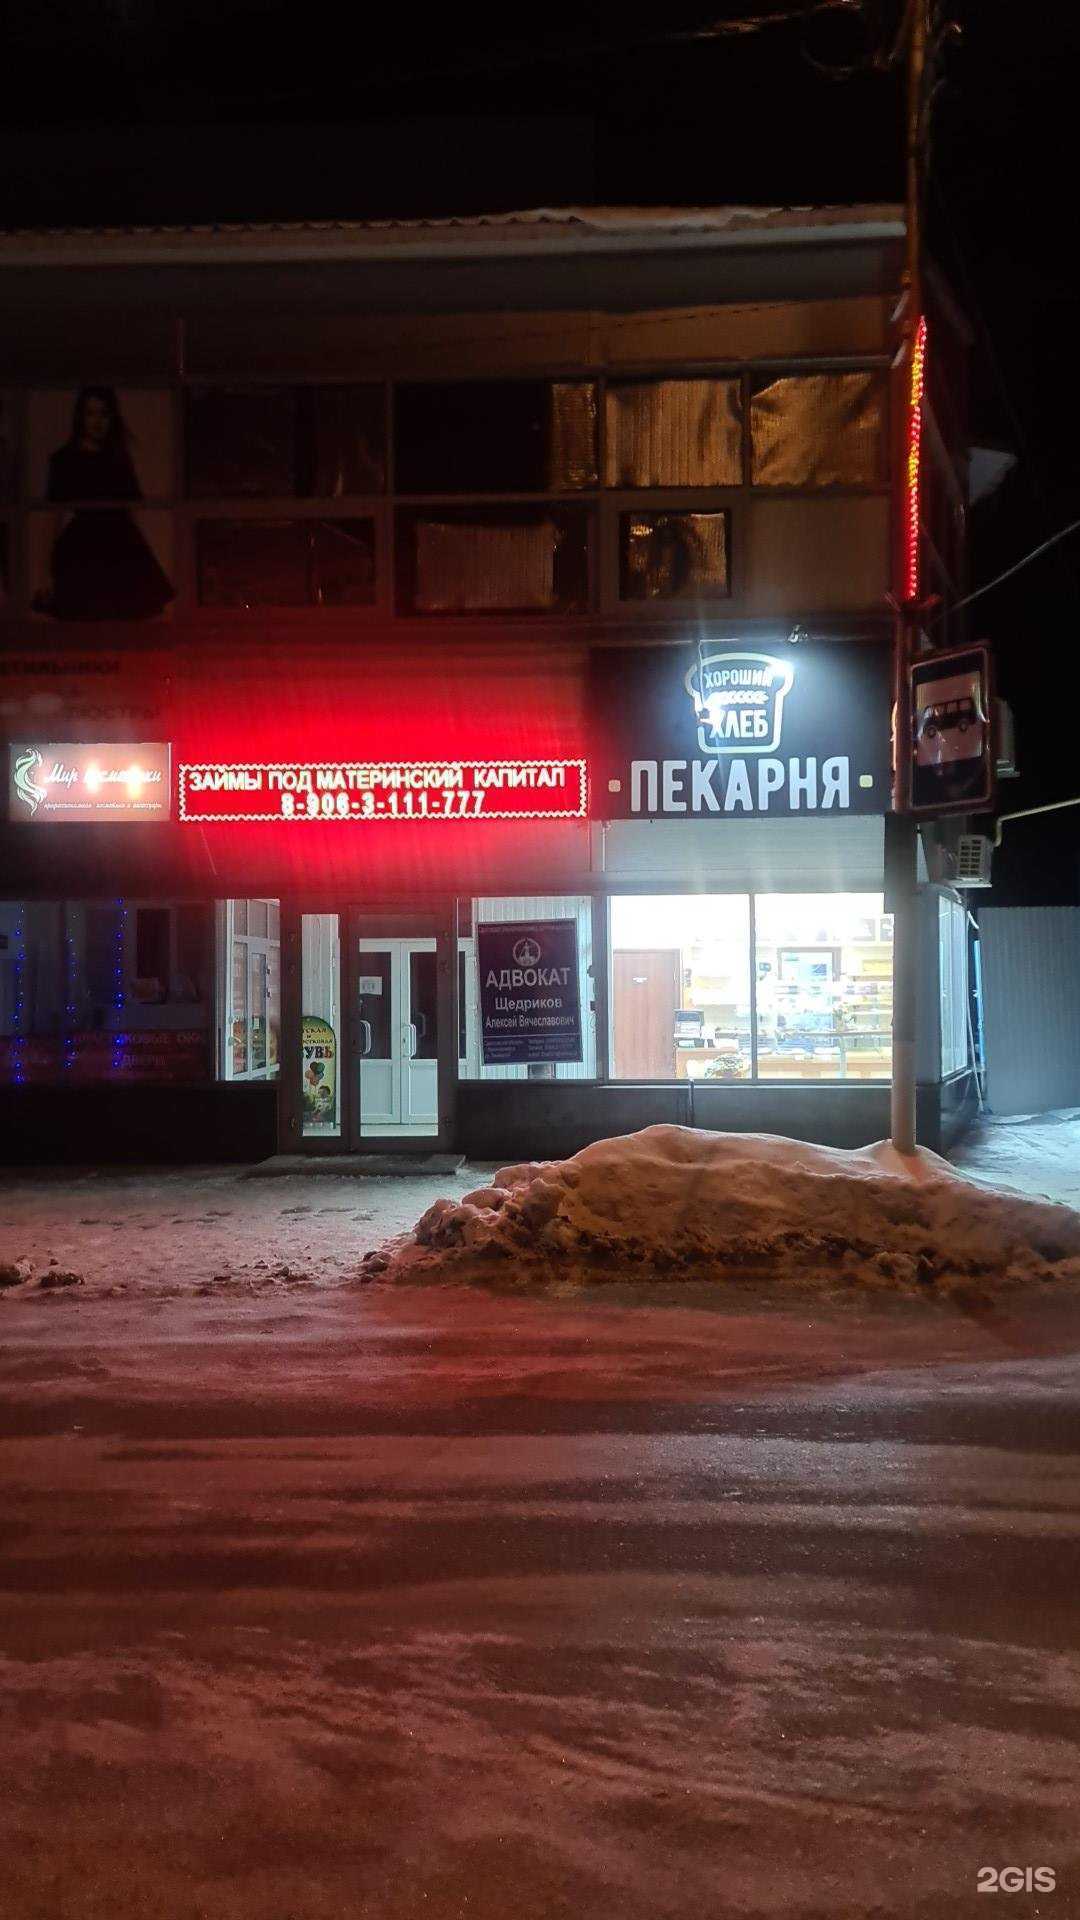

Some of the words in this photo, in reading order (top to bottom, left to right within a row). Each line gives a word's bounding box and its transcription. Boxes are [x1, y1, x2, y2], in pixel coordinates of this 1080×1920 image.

[709, 709, 768, 738] ХЛЕБ
[189, 767, 262, 790] ЗАЙМЫ
[268, 769, 311, 792] ПОД
[316, 766, 462, 789] МАТЕРИНСКИЙ
[474, 768, 565, 788] КАПИТАЛ
[631, 756, 850, 812] ПЕКАРНЯ
[486, 967, 571, 991] АДВОКАТ
[495, 997, 564, 1013] Щедриков
[486, 1016, 517, 1029] Алексей
[519, 1014, 575, 1028] Вячеславович
[304, 1046, 333, 1060] УВЬ
